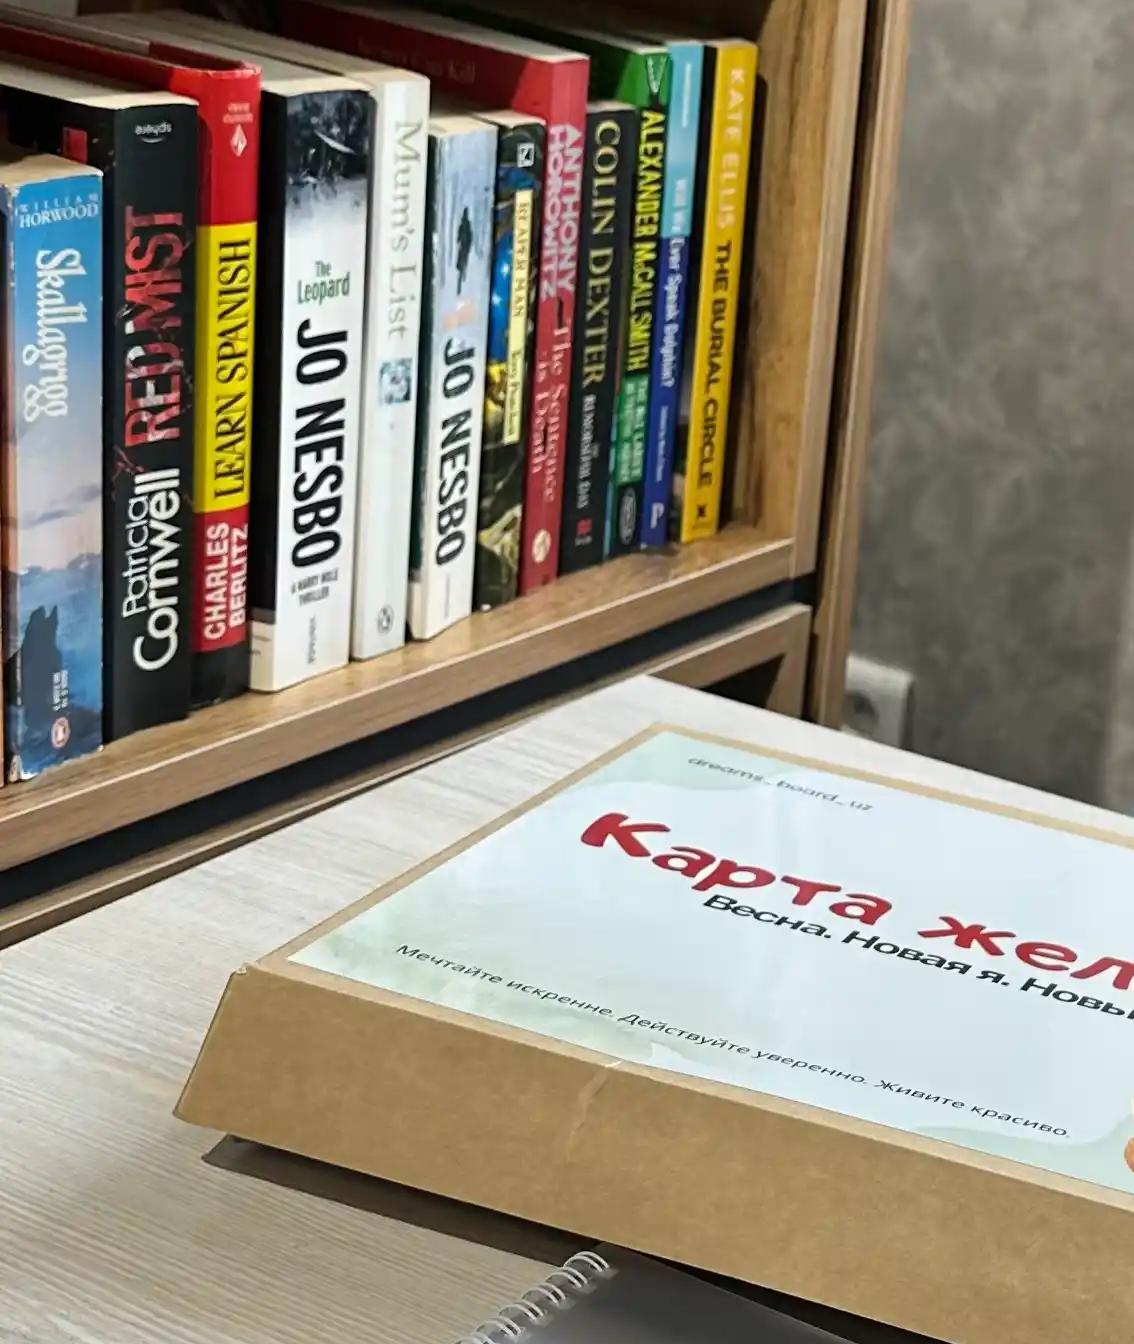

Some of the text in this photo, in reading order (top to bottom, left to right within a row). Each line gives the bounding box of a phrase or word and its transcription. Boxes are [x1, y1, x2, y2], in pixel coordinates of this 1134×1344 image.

[134, 121, 173, 139] sphere
[633, 109, 666, 238] ALEXANDER
[19, 202, 99, 230] HORWOOD
[314, 259, 332, 278] The
[388, 119, 424, 341] Mum's List
[539, 123, 564, 303] HOROWITZ
[555, 122, 584, 295] ANTHONY
[582, 118, 622, 389] COLIN DEXTER
[124, 205, 184, 447] RED MIST
[297, 271, 352, 306] Leopard
[630, 238, 659, 309] McCALL
[663, 273, 683, 321] Speak
[698, 67, 746, 488] KATE ELLIS THE BURIAL CIRCLE
[213, 238, 251, 500] LEARN SPANISH
[295, 318, 348, 387] JO
[627, 309, 653, 372] SMITH
[435, 335, 475, 567] JO NESBO
[543, 318, 572, 504] The Sentence
[291, 397, 347, 569] NESBO
[121, 494, 149, 618] Patricia
[132, 467, 182, 672] Cornwell
[203, 521, 230, 641] CHARLES
[229, 522, 249, 628] BERLITZ
[580, 812, 892, 927] Карта
[703, 894, 833, 940] Весна.
[841, 929, 972, 976] Новая
[976, 967, 1010, 987] я.
[395, 943, 1072, 1139] Мечтайте искренне. Действуйте уверенно. Живите красиво.
